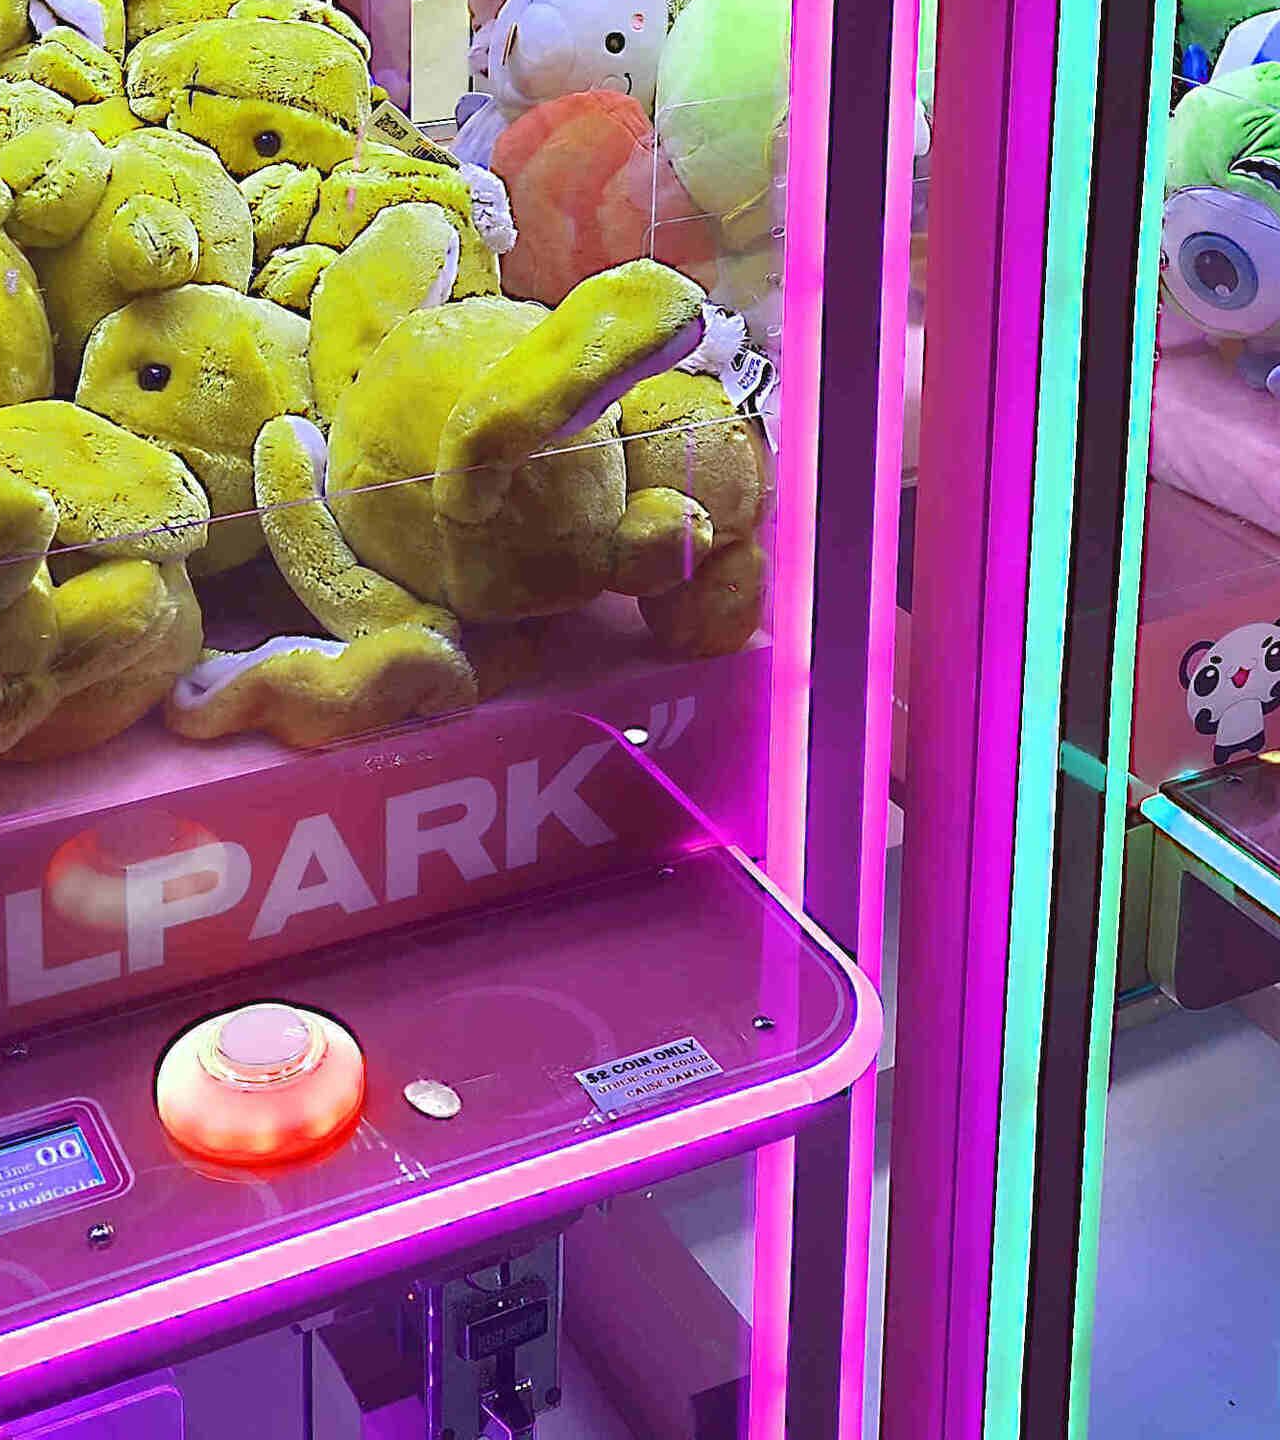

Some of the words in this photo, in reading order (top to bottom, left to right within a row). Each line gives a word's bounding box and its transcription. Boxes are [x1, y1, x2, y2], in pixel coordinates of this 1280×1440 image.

[586, 1069, 611, 1085] $2
[611, 1055, 653, 1076] COIN
[655, 1039, 698, 1062] ONLY
[35, 1139, 81, 1166] 00
